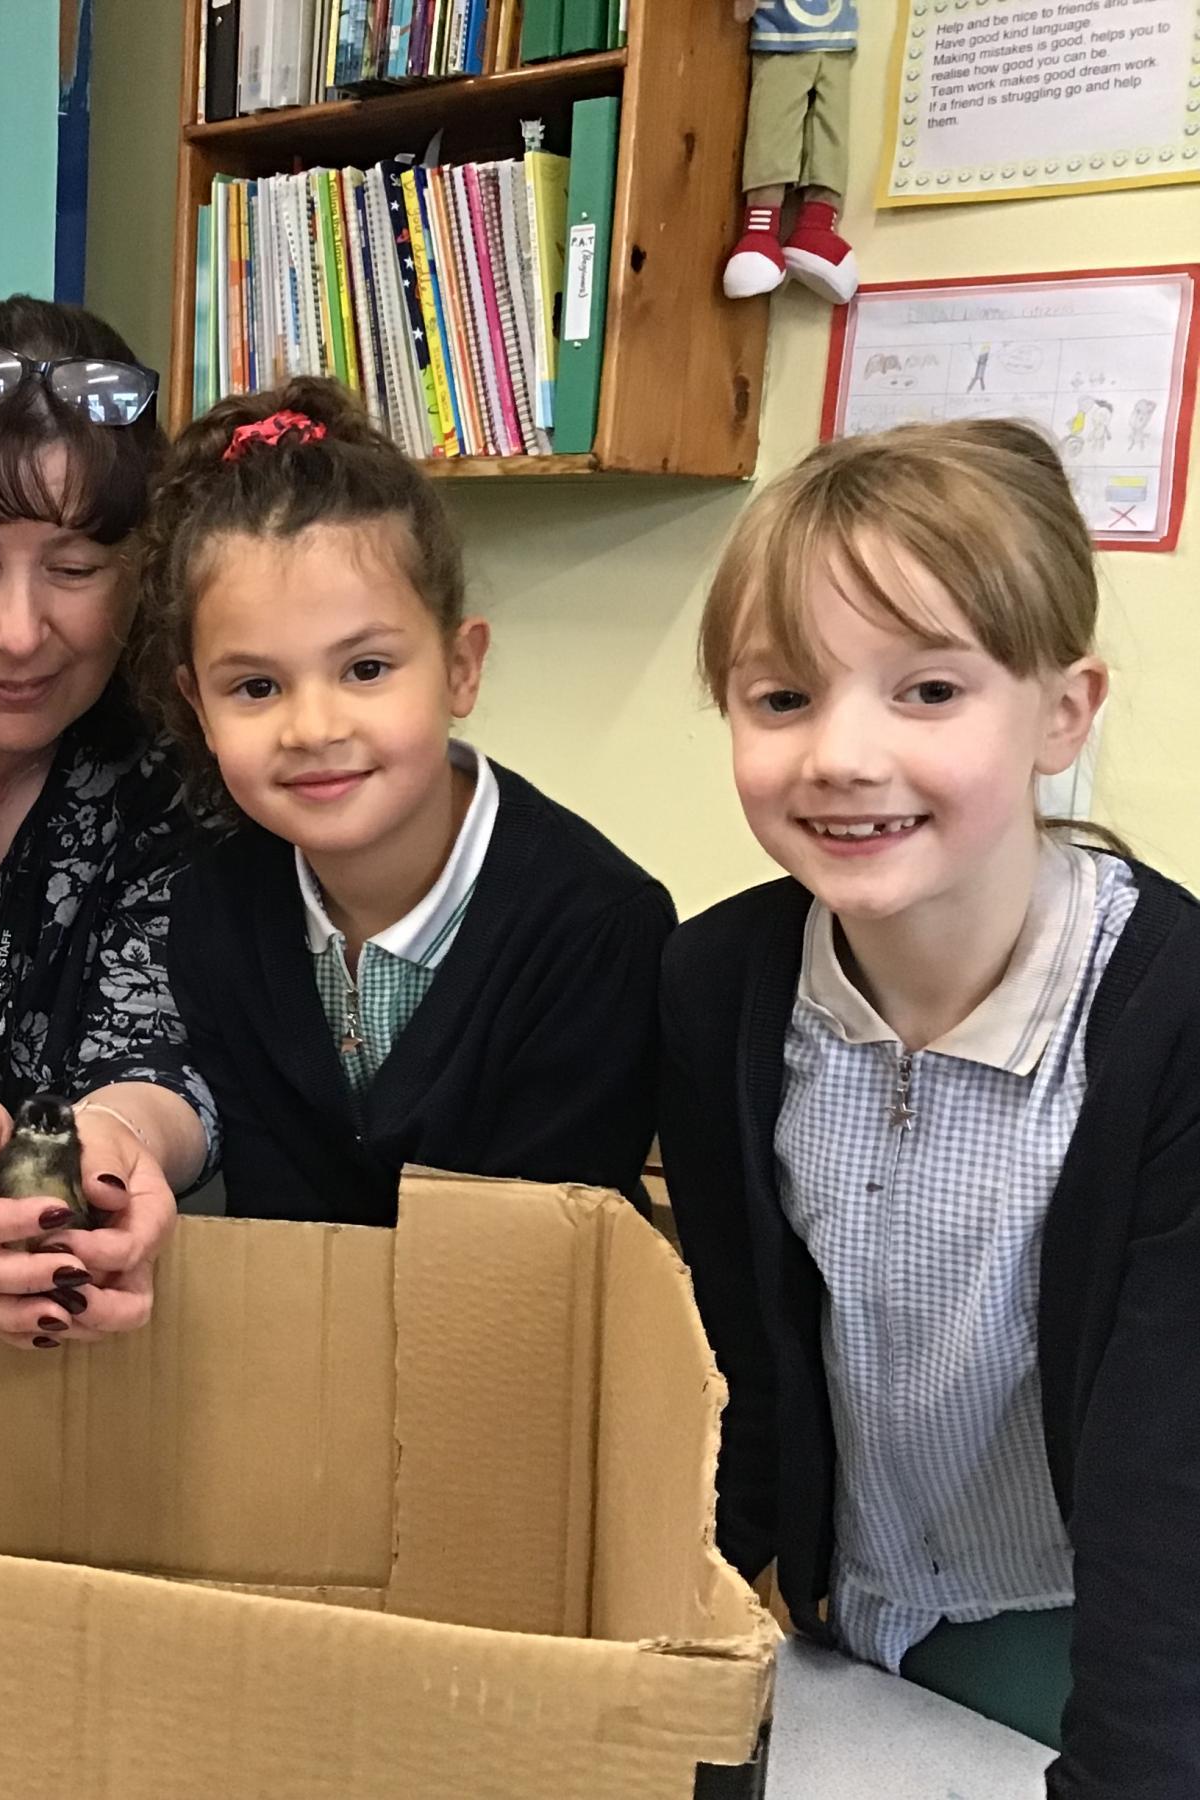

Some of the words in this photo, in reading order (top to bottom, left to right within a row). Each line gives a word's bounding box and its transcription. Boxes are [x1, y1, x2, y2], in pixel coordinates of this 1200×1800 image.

[937, 22, 963, 35] Help
[967, 18, 990, 31] and
[993, 15, 1009, 26] be
[1013, 11, 1038, 23] nice
[1042, 8, 1054, 19] to
[1057, 1, 1100, 16] friends
[933, 51, 976, 67] Making
[979, 43, 1033, 60] mistakes
[1037, 41, 1048, 51] is
[1090, 29, 1126, 43] helps
[1130, 25, 1154, 40] you
[1158, 22, 1171, 33] to
[935, 38, 966, 51] Have
[969, 32, 1000, 48] good
[1003, 28, 1029, 40] kind
[1032, 19, 1091, 36] language
[931, 67, 970, 82] realise
[974, 62, 999, 75] how
[1002, 58, 1034, 74] good
[1037, 56, 1060, 69] you
[1063, 51, 1087, 63] can
[931, 84, 964, 97] Team
[967, 79, 996, 92] work
[1000, 73, 1040, 87] makes
[1044, 67, 1076, 85] good
[1079, 62, 1121, 78] dream
[929, 101, 938, 113] If
[939, 102, 947, 112] a
[950, 96, 985, 110] friend
[987, 94, 998, 105] is
[1001, 86, 1062, 104] struggling
[1065, 84, 1082, 98] go
[1085, 79, 1111, 93] and
[1114, 75, 1142, 89] help
[403, 179, 415, 199] Do
[406, 207, 422, 233] you
